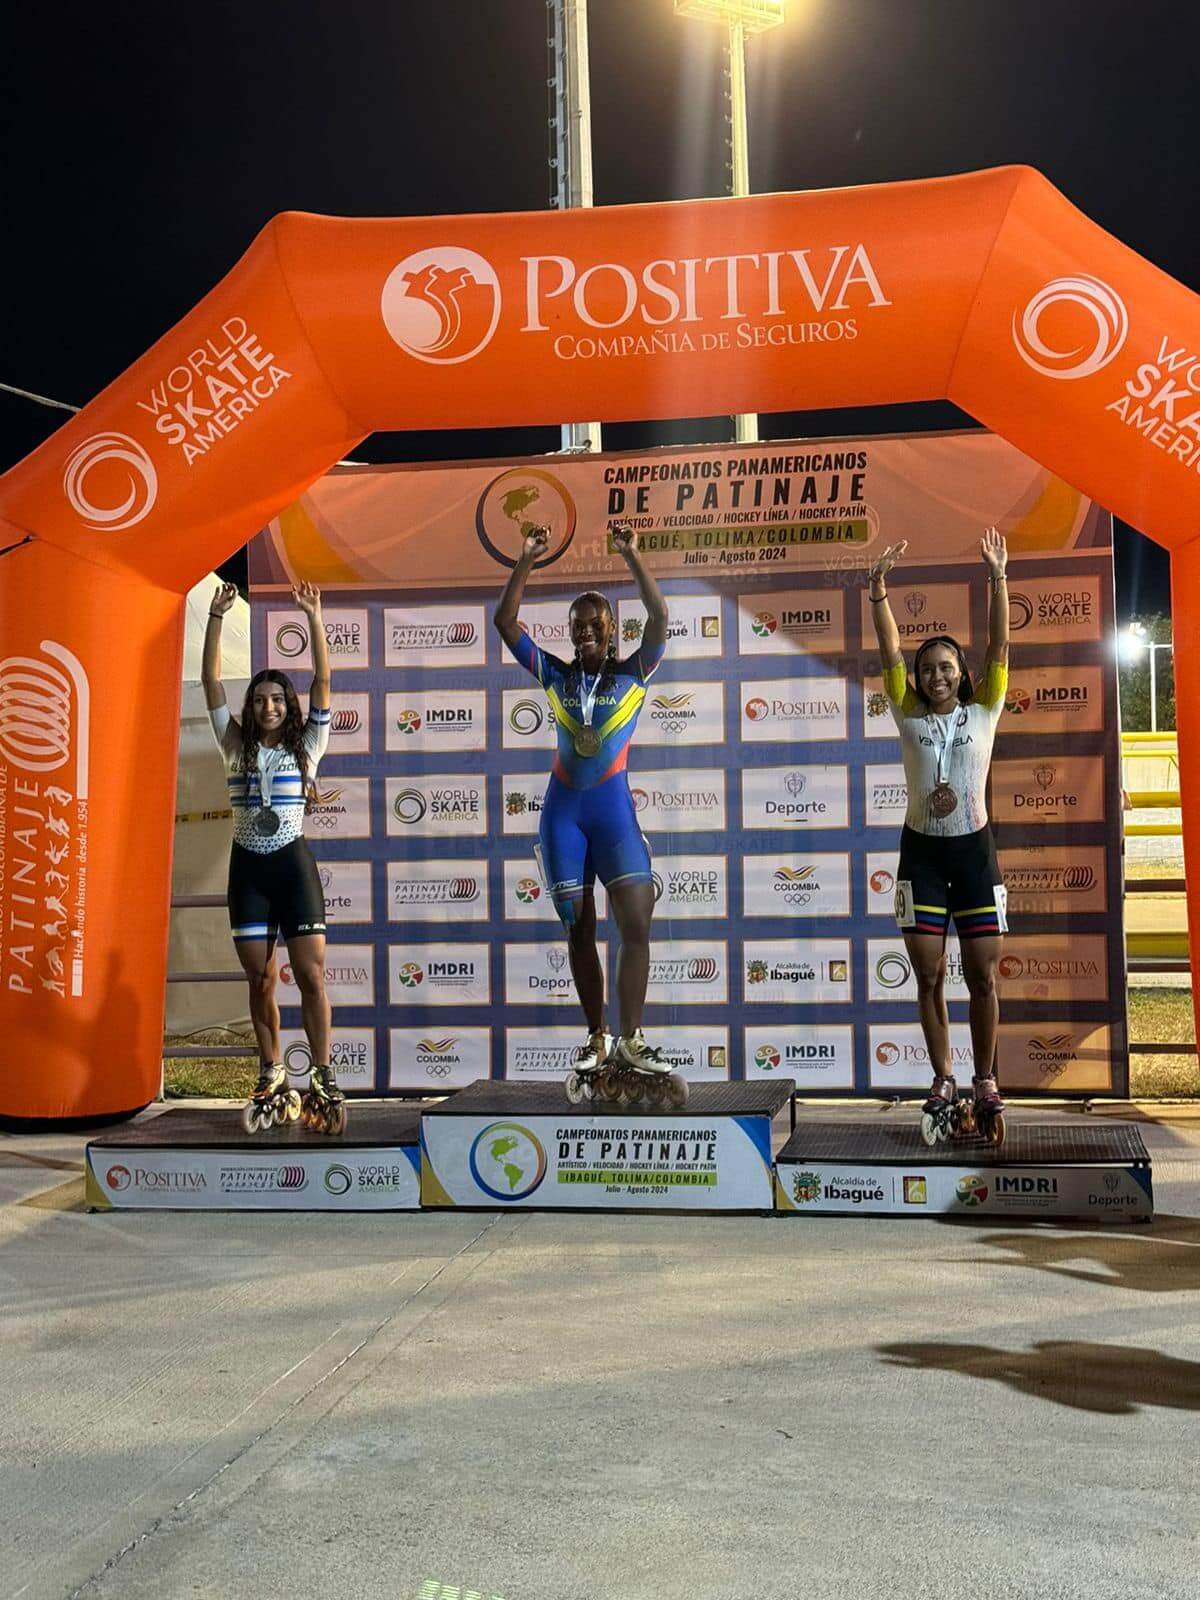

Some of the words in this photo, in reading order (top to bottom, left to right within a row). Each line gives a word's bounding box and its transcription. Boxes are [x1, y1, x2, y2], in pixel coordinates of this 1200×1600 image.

[520, 244, 892, 332] POSITIVA
[554, 330, 695, 360] COMPAÑIA
[702, 334, 731, 350] DE
[736, 320, 858, 349] SEGUROS
[137, 316, 247, 415] WORLD
[156, 334, 274, 445] SKATE
[182, 365, 292, 466] AMERICA
[1105, 396, 1200, 473] AMERI
[604, 461, 722, 484] CAMPEONATOS
[727, 451, 867, 477] PANAMERICANOS
[608, 486, 650, 515] DE
[676, 474, 866, 511] PATINAJE
[663, 513, 714, 527] VELOCIDAD
[724, 510, 761, 523] HOCKEY
[763, 507, 789, 522] LÍNEA
[799, 506, 836, 519] HOCKEY
[839, 504, 867, 517] PATÍN
[639, 529, 686, 551] AGUÉ,
[694, 524, 854, 547] TOLIMA/COLOMBIA
[683, 551, 709, 565] Julio
[719, 548, 756, 564] Agosto
[758, 547, 787, 561] 2024
[1038, 591, 1091, 604] WORLD
[782, 610, 831, 624] IMDRI
[1038, 603, 1091, 618] SKATE
[1038, 616, 1091, 627] AMERICA
[323, 623, 360, 634] ORLD
[392, 629, 446, 639] PATINAJE
[665, 624, 688, 640] gué
[898, 621, 947, 637] eporte
[326, 634, 360, 646] KATE
[328, 645, 360, 654] ERICA
[1036, 687, 1088, 701] IMDRI
[562, 695, 617, 708] COLBIA
[771, 700, 840, 716] POSITIVA
[426, 709, 473, 722] IMDRI
[651, 710, 697, 720] COLOMBIA
[431, 790, 479, 800] WORLD
[652, 791, 719, 807] POSITIVA
[873, 789, 908, 798] PATIN
[431, 800, 479, 812] SKATE
[1014, 793, 1078, 810] Deporte
[311, 805, 347, 814] OLOMBIA
[765, 801, 826, 816] Deporte
[431, 811, 479, 821] AMERICA
[76, 832, 88, 863] desde
[668, 871, 718, 882] WORLD
[8, 775, 45, 994] PATINAJE
[395, 883, 449, 894] PATINAJE
[668, 882, 718, 894] SKATE
[773, 882, 821, 891] COLOMBIA
[324, 896, 352, 908] orte
[668, 894, 718, 903] AMERICA
[428, 962, 474, 976] IMDRI
[648, 965, 685, 974] TINAJE
[801, 962, 810, 970] de
[1026, 959, 1099, 975] POSITIVA
[324, 967, 368, 980] SITIVA
[770, 969, 815, 985] Ibagué
[529, 976, 572, 991] Depor
[330, 1042, 367, 1054] ORLD
[786, 1045, 835, 1058] IMDRI
[904, 1045, 973, 1061] POIVA
[329, 1054, 367, 1066] KATE
[417, 1055, 460, 1064] COLOMBIA
[515, 1053, 569, 1061] PATINAJE
[664, 1054, 694, 1069] agué
[1028, 1051, 1078, 1061] COLOMBIA
[336, 1065, 366, 1074] ERICA
[556, 1128, 629, 1141] CAMPEONATOS
[631, 1129, 717, 1141] PANAMERICANOS
[559, 1142, 585, 1159] DE
[601, 1142, 716, 1161] PATINAJE
[357, 1166, 400, 1176] WORLD
[557, 1160, 588, 1169] ARTÍSTICO
[592, 1161, 624, 1169] VELOCIDAD
[630, 1162, 652, 1170] HOCKEY
[676, 1162, 698, 1170] HOCKEY
[134, 1168, 208, 1187] POSITIVA
[220, 1172, 276, 1181] PATINAJE
[358, 1175, 400, 1186] SKATE
[612, 1173, 710, 1184] TOLIMA/COLOMBIA
[831, 1176, 863, 1187] Alcaldía
[865, 1177, 877, 1187] de
[358, 1185, 400, 1193] AMERICA
[606, 1185, 621, 1194] Julio
[627, 1186, 649, 1194] Agosto
[651, 1185, 668, 1193] 2024
[995, 1176, 1058, 1193] IMDRI
[824, 1185, 884, 1204] Ibagué
[1088, 1193, 1138, 1207] Deporte
